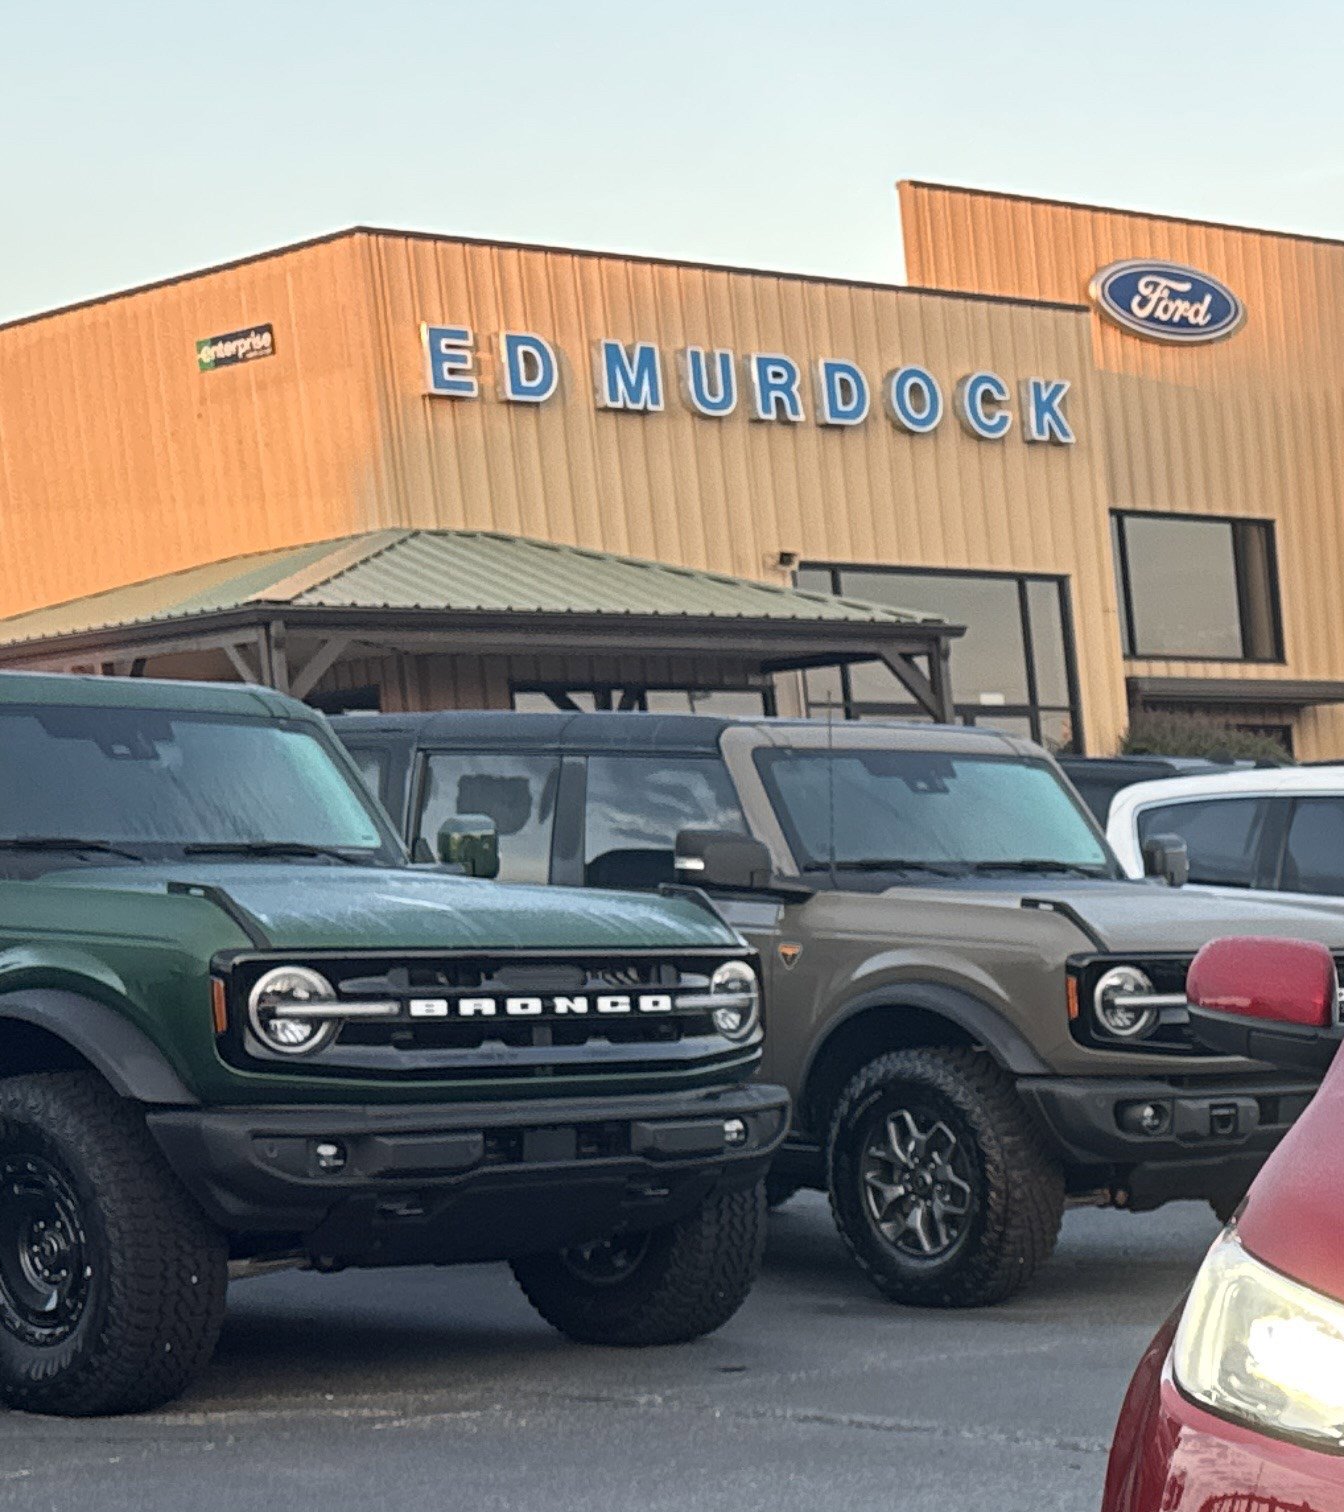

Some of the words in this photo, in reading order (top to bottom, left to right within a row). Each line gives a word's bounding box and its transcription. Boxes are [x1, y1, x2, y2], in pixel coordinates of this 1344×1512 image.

[1130, 275, 1212, 326] Ford
[198, 329, 272, 363] enterprise
[420, 321, 559, 402] ED
[595, 338, 1076, 444] MURDOCK
[409, 995, 672, 1017] BRONCO
